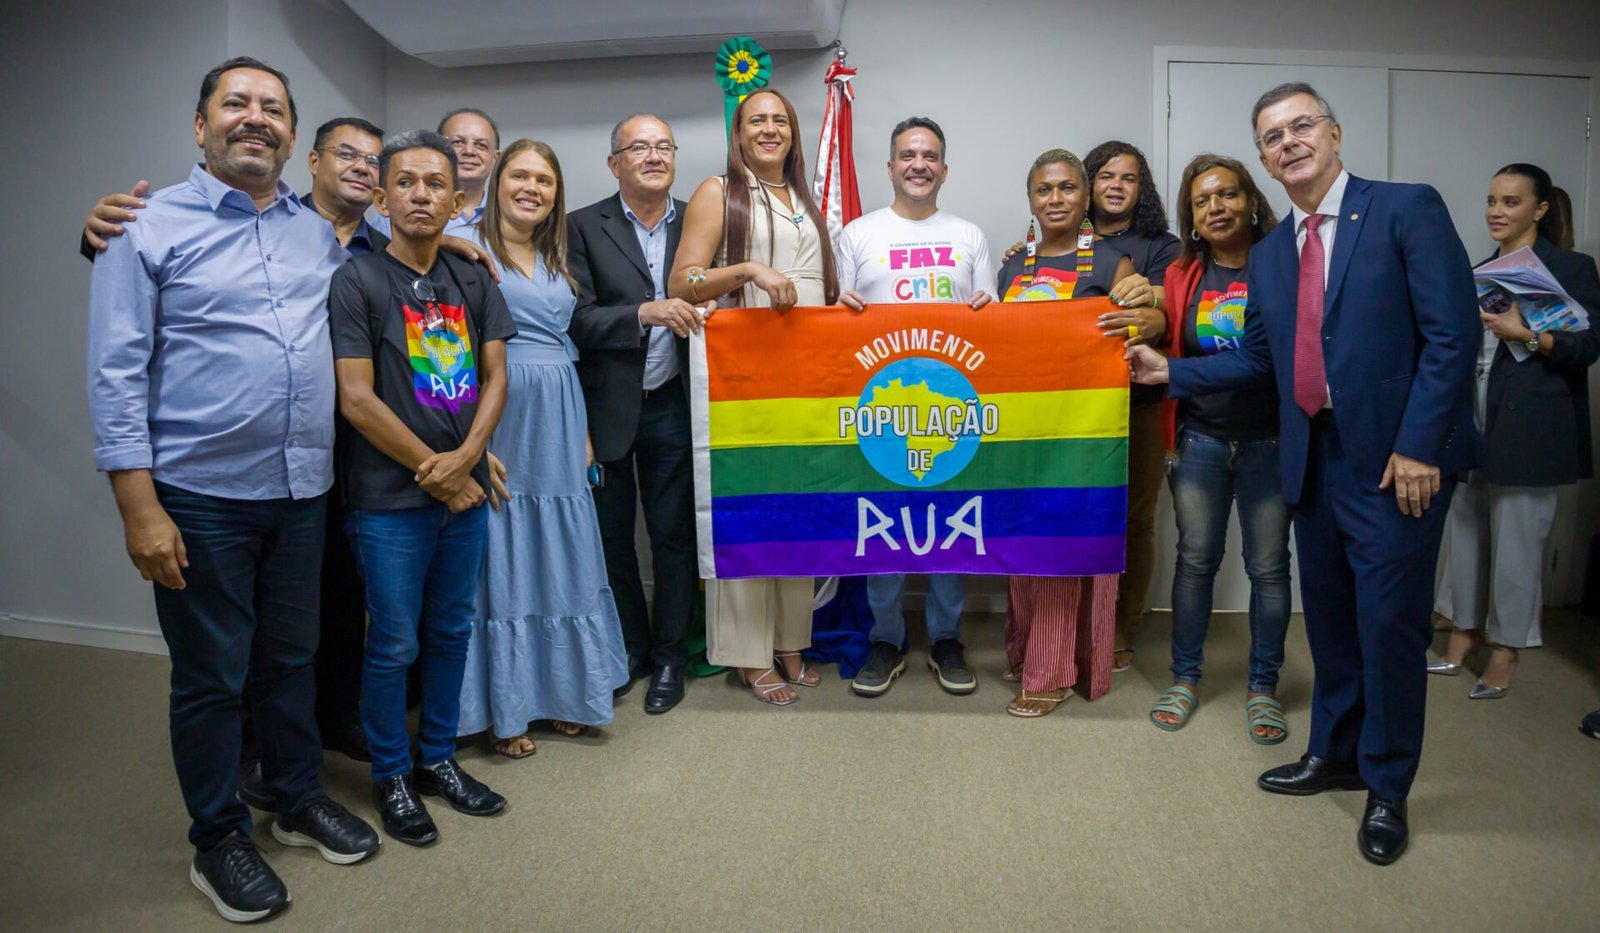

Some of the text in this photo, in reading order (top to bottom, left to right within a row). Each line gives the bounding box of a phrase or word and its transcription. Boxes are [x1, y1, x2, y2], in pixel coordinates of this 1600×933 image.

[889, 247, 956, 270] FAZ
[895, 272, 953, 300] cria
[854, 328, 985, 371] MOVIMENTO
[838, 398, 999, 441] POPULAÇÃO
[907, 449, 932, 472] DE
[855, 495, 986, 557] RUA
